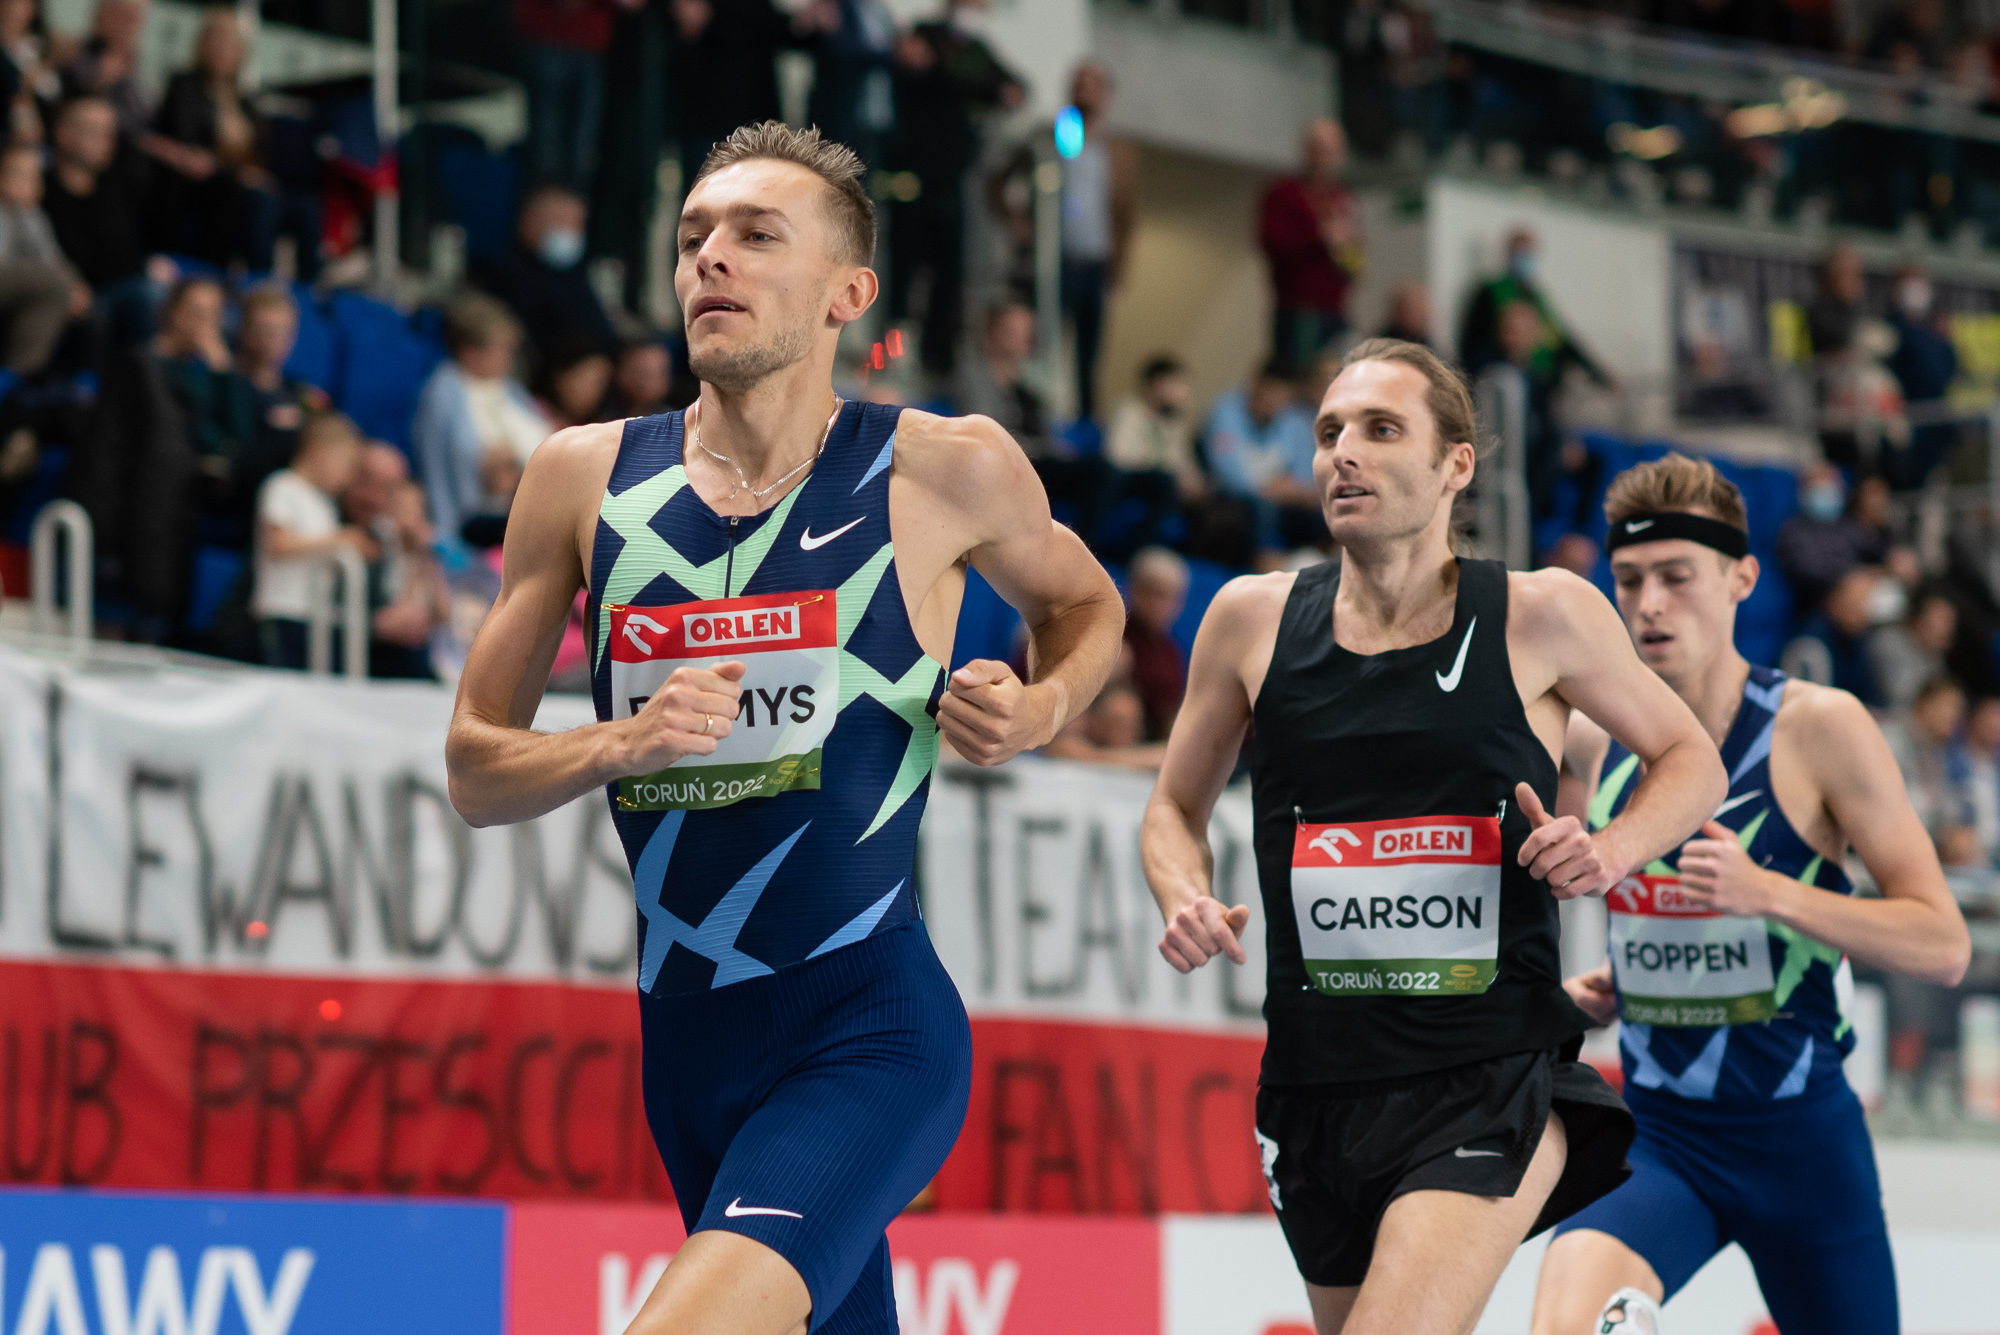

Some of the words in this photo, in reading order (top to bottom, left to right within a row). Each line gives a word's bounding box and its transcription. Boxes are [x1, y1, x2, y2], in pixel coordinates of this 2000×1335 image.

[690, 611, 792, 643] ORLEN
[633, 777, 706, 803] TORUŃ
[712, 774, 766, 802] 2022
[1379, 830, 1465, 854] ORLEN
[1310, 895, 1482, 931] CARSON
[1625, 940, 1748, 972] FOPPEN
[1317, 968, 1383, 989] TORUŃ
[1387, 971, 1440, 990] 2022
[1680, 1006, 1728, 1025] 2022
[989, 1058, 1156, 1217] FAN
[0, 1243, 316, 1335] AWY
